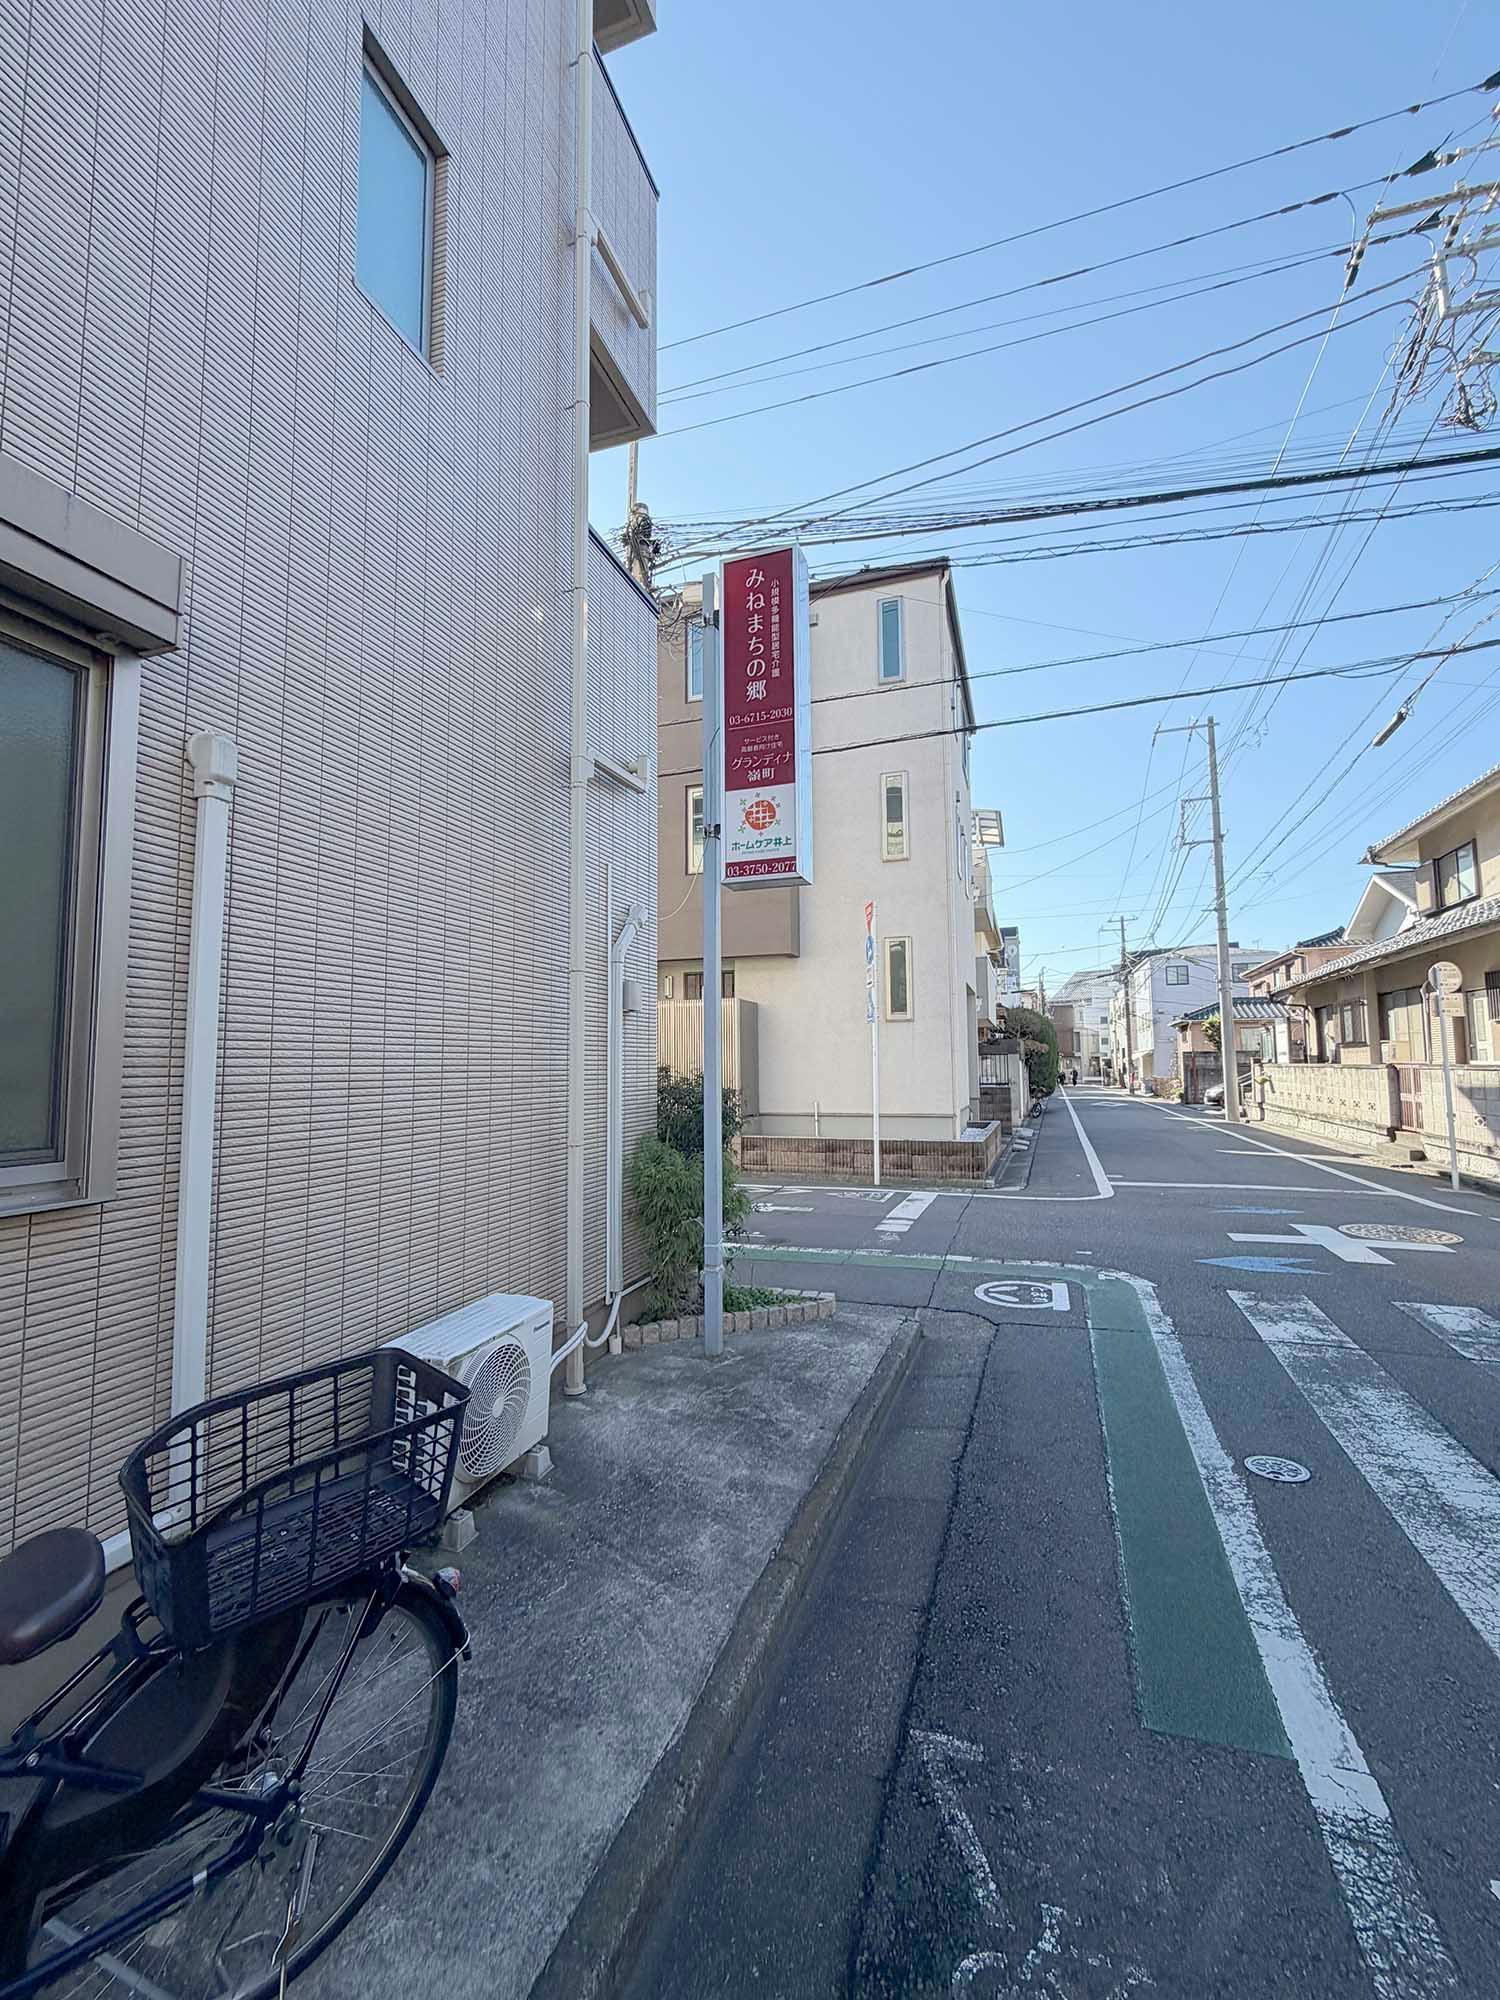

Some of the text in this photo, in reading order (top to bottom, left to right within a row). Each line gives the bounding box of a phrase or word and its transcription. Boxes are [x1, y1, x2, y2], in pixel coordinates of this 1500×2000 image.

[745, 568, 767, 703] みねまちの郷
[729, 707, 793, 726] 03-6715-2030
[744, 734, 780, 745] サービス付き
[731, 751, 793, 770] グランディナ
[731, 836, 793, 851] ホームケア井上
[727, 860, 796, 877] 03-3750-2077
